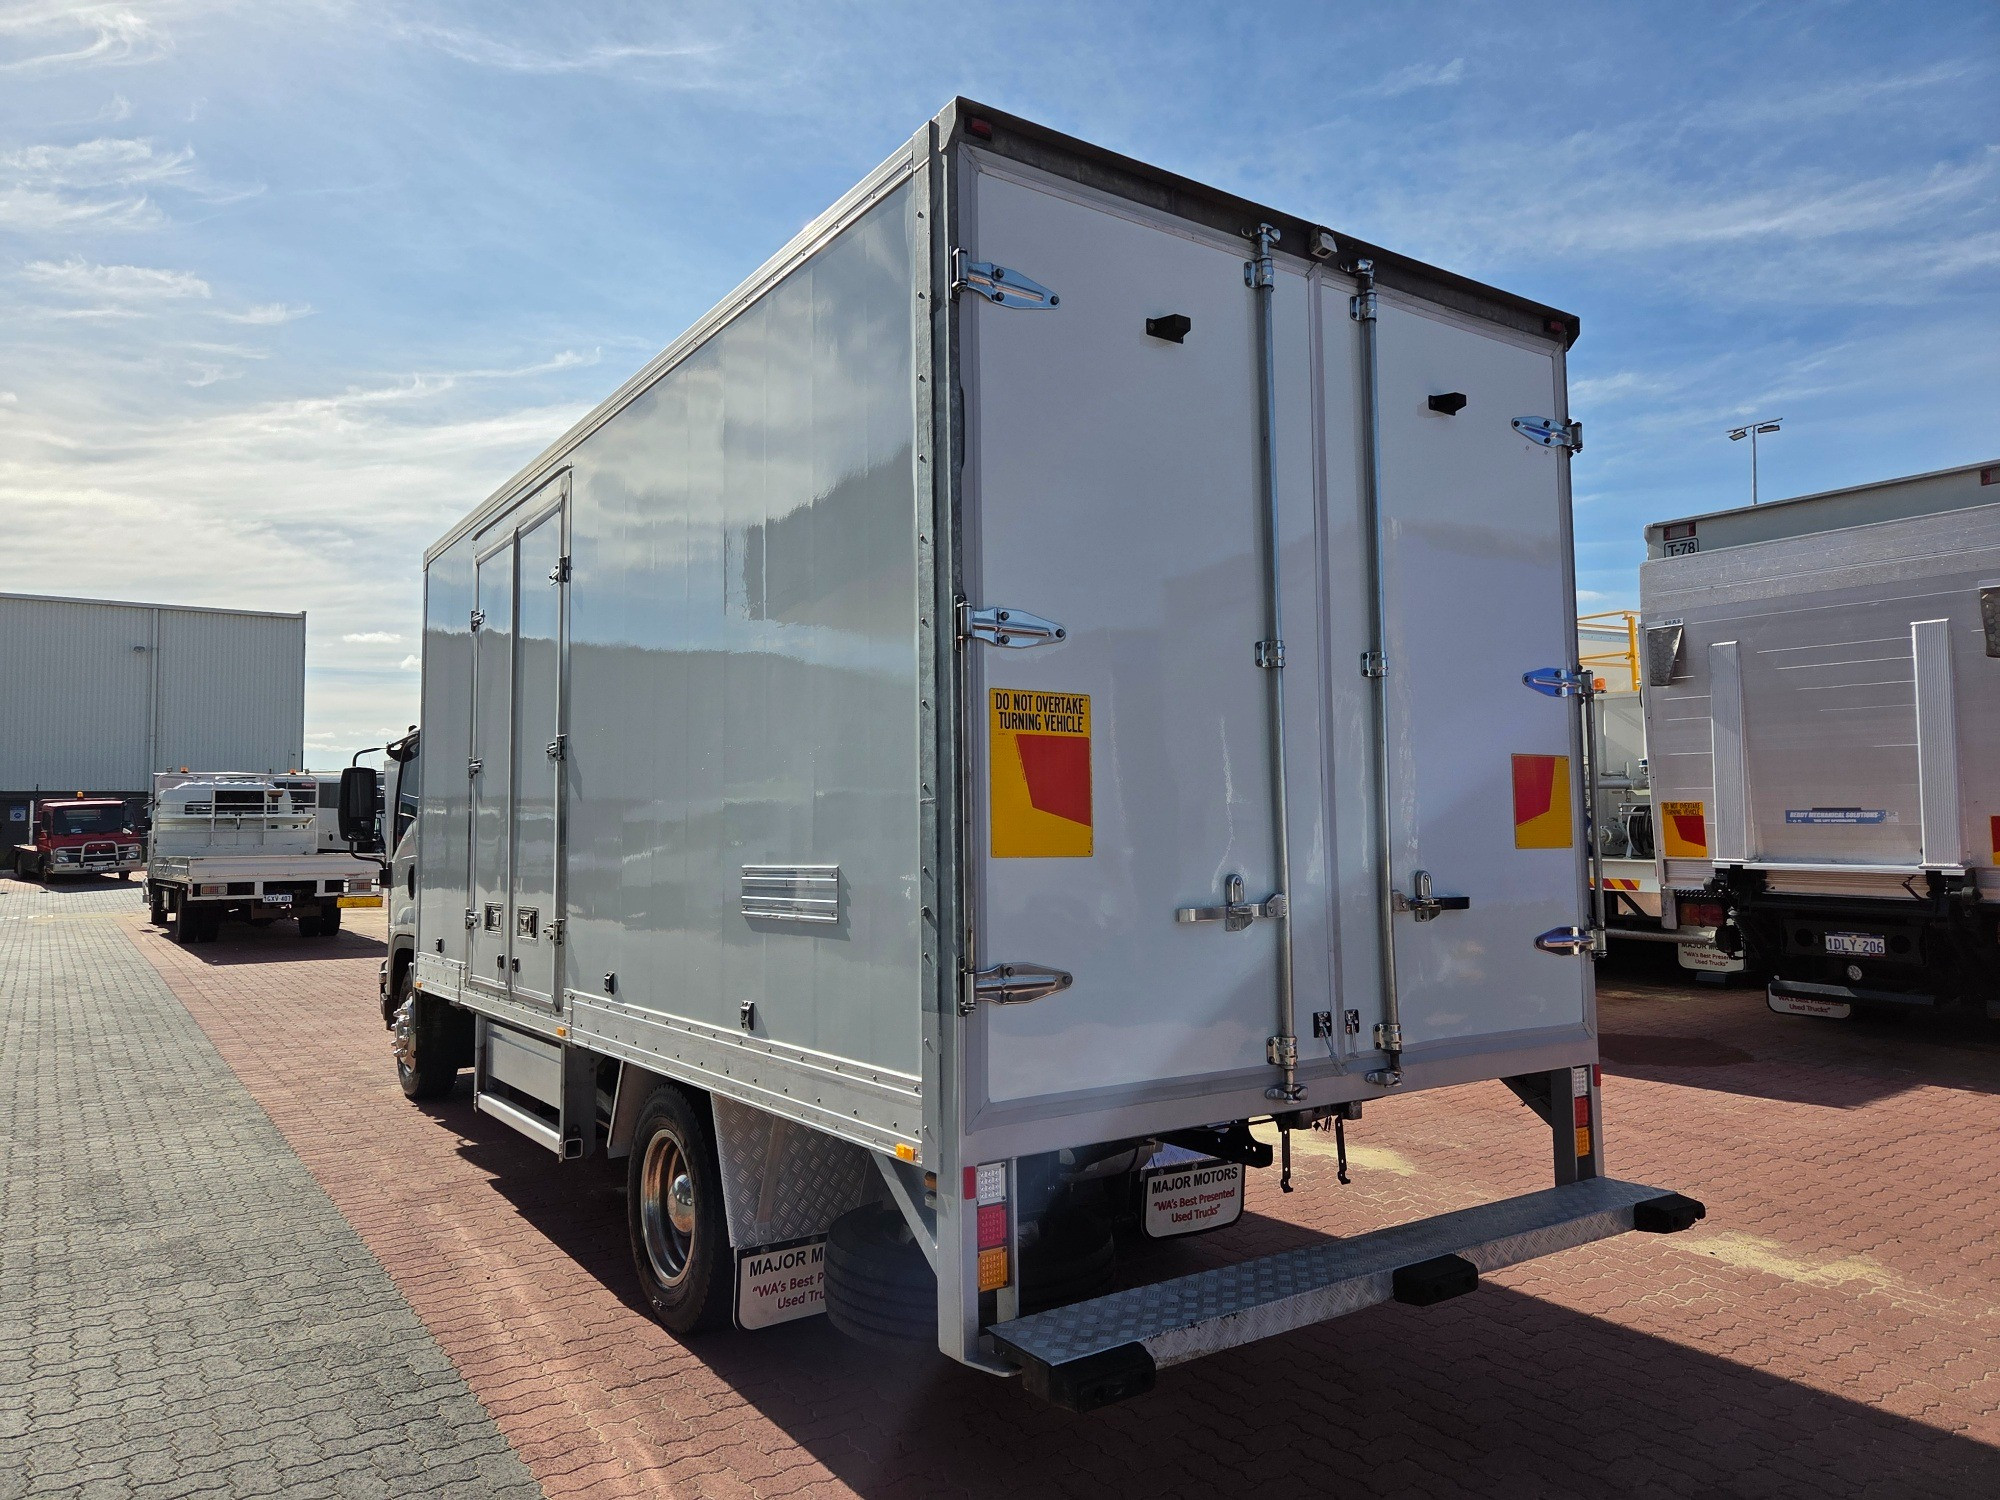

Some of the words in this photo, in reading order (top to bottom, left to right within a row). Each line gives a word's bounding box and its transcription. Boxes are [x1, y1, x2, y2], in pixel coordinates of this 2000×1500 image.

[1667, 542, 1696, 556] T-78
[995, 693, 1009, 710] DO
[1014, 694, 1033, 711] NOT
[1036, 696, 1084, 714] OVERTAKE
[999, 712, 1041, 730] TURNING
[1044, 714, 1083, 733] VEHICLE
[1152, 1176, 1191, 1194] MAJOR
[1194, 1167, 1238, 1187] MOTORS
[1180, 1196, 1197, 1208] Best
[1200, 1187, 1235, 1204] Presented
[1171, 1210, 1192, 1223] Used
[749, 1251, 806, 1277] MAJOR
[789, 1275, 814, 1290] Best
[777, 1291, 805, 1309] Used
